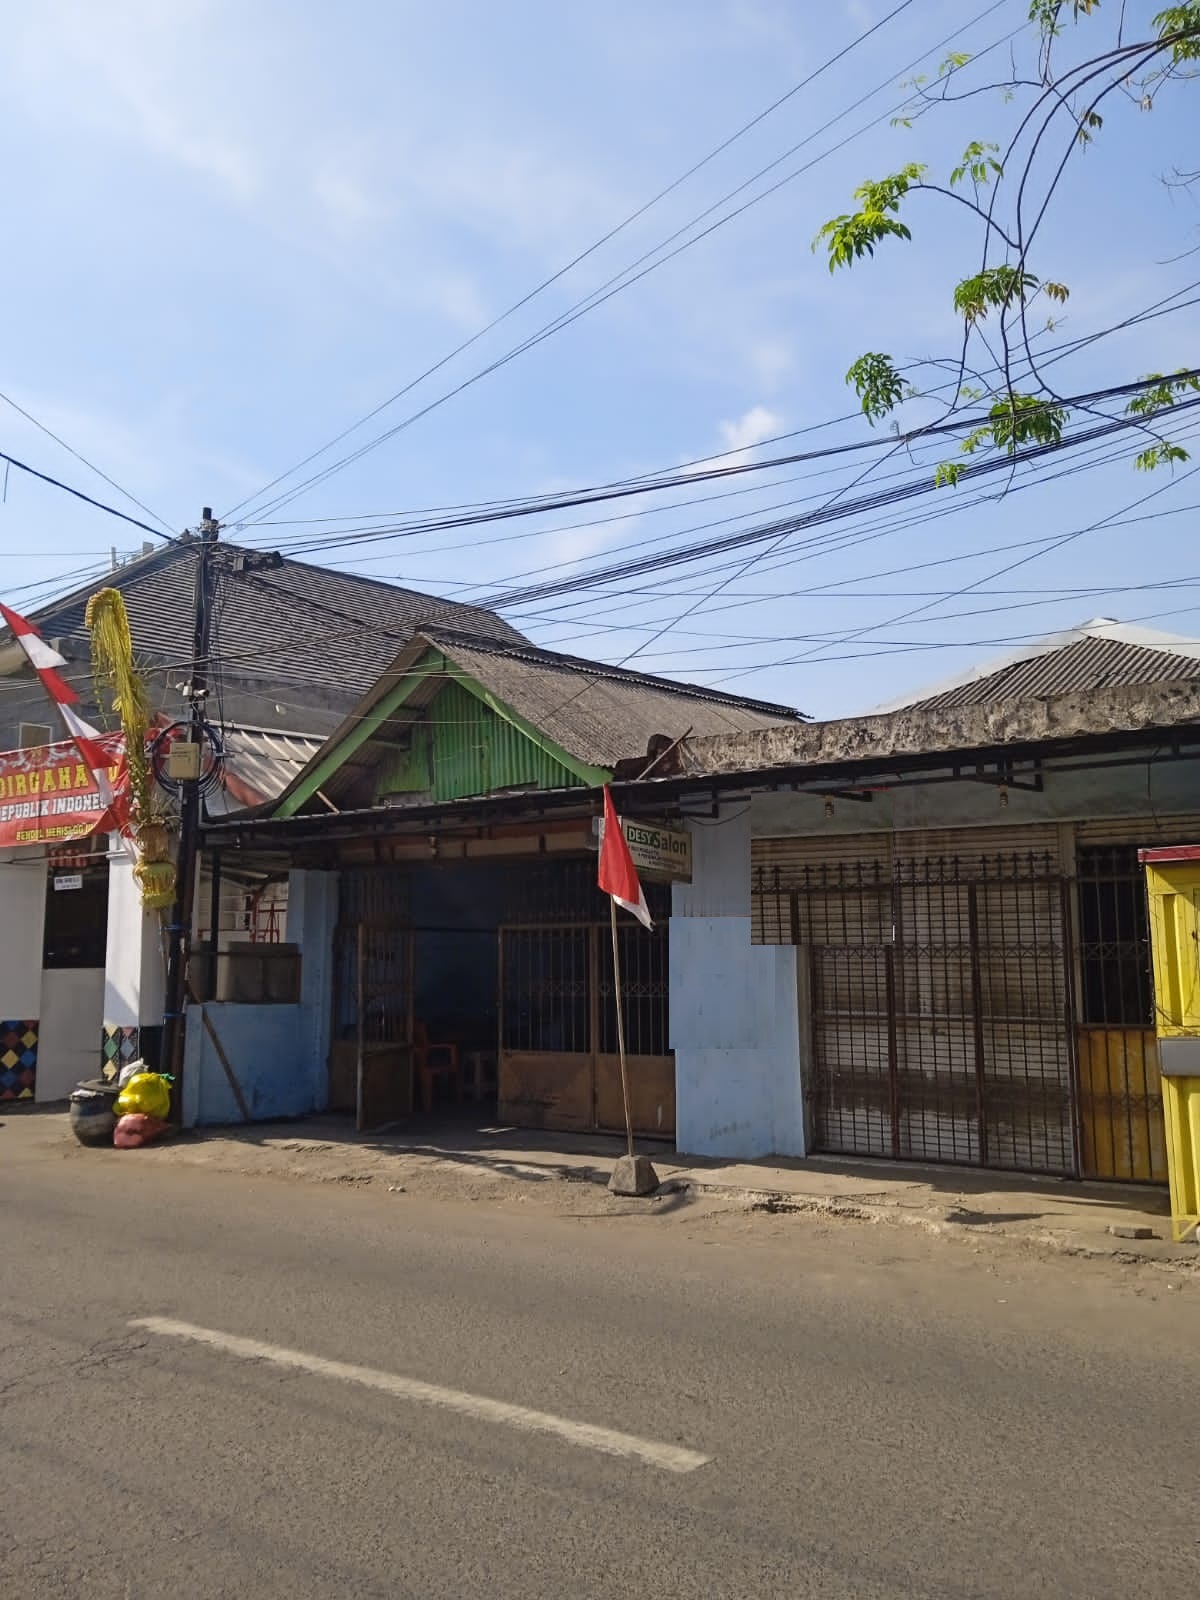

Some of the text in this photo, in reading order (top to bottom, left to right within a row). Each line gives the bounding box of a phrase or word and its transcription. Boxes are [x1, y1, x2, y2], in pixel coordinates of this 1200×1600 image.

[0, 761, 118, 798] DIRGAHAU
[0, 800, 49, 820] EPUBLIK
[628, 827, 653, 844] DESY
[653, 831, 687, 856] Salon
